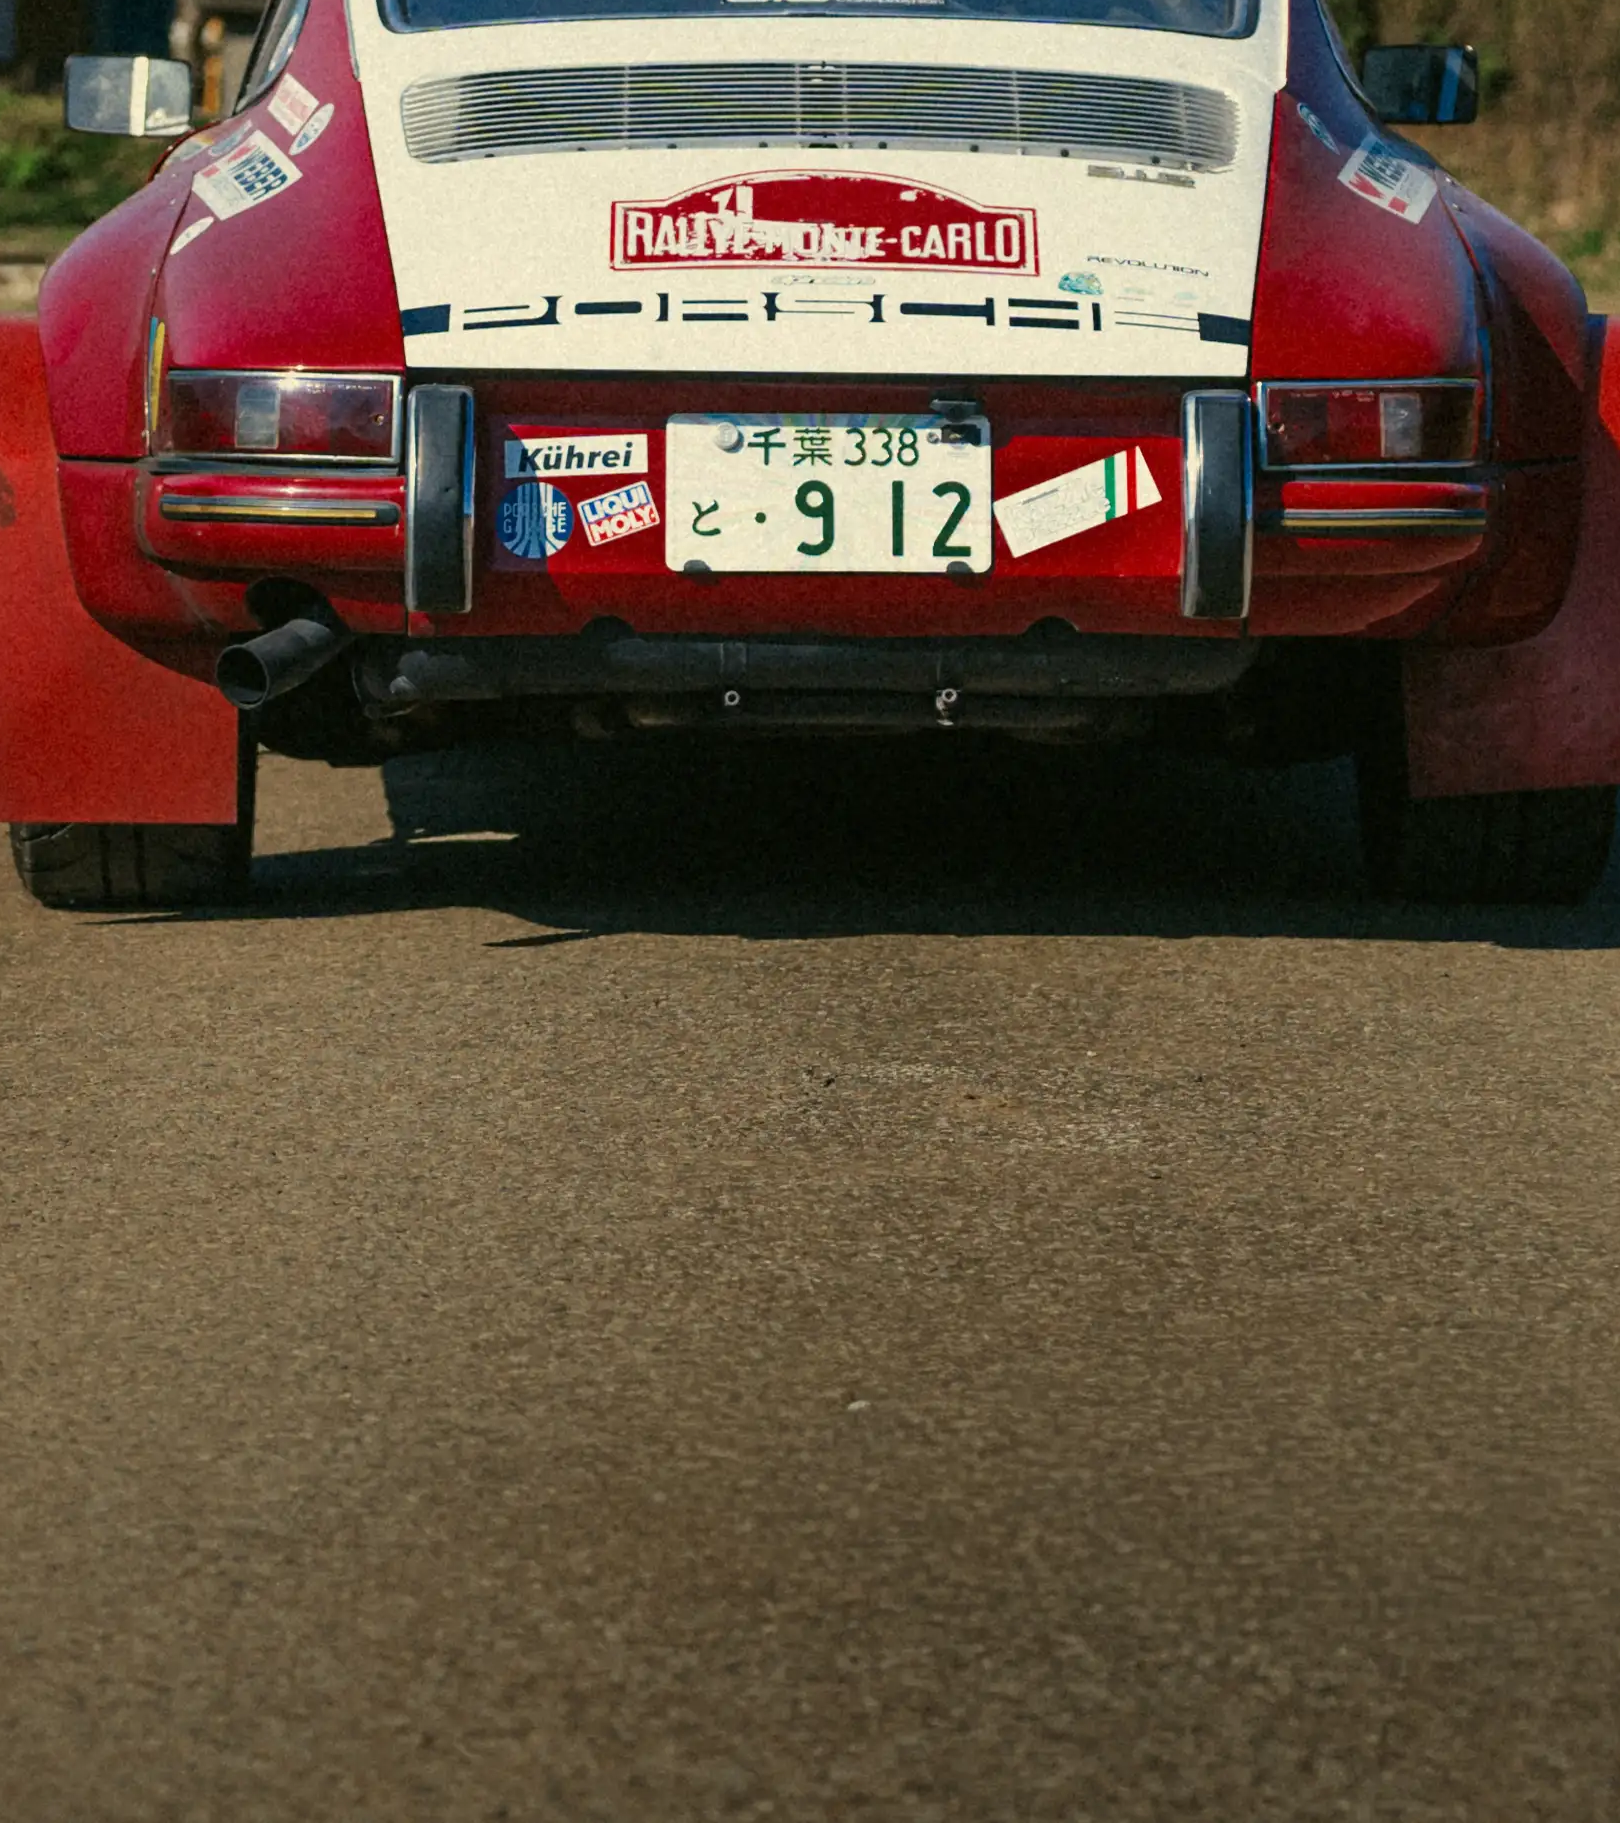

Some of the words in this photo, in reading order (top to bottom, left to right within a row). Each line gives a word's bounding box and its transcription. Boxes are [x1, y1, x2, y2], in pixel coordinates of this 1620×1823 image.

[626, 210, 754, 258] RALLYE
[762, 215, 1022, 264] MONTE-CARLO
[518, 441, 633, 473] Kührei
[747, 427, 833, 466] 千葉
[844, 427, 919, 466] 338
[503, 502, 567, 518] POCHE
[582, 485, 648, 522] LIQUI
[692, 498, 721, 536] と
